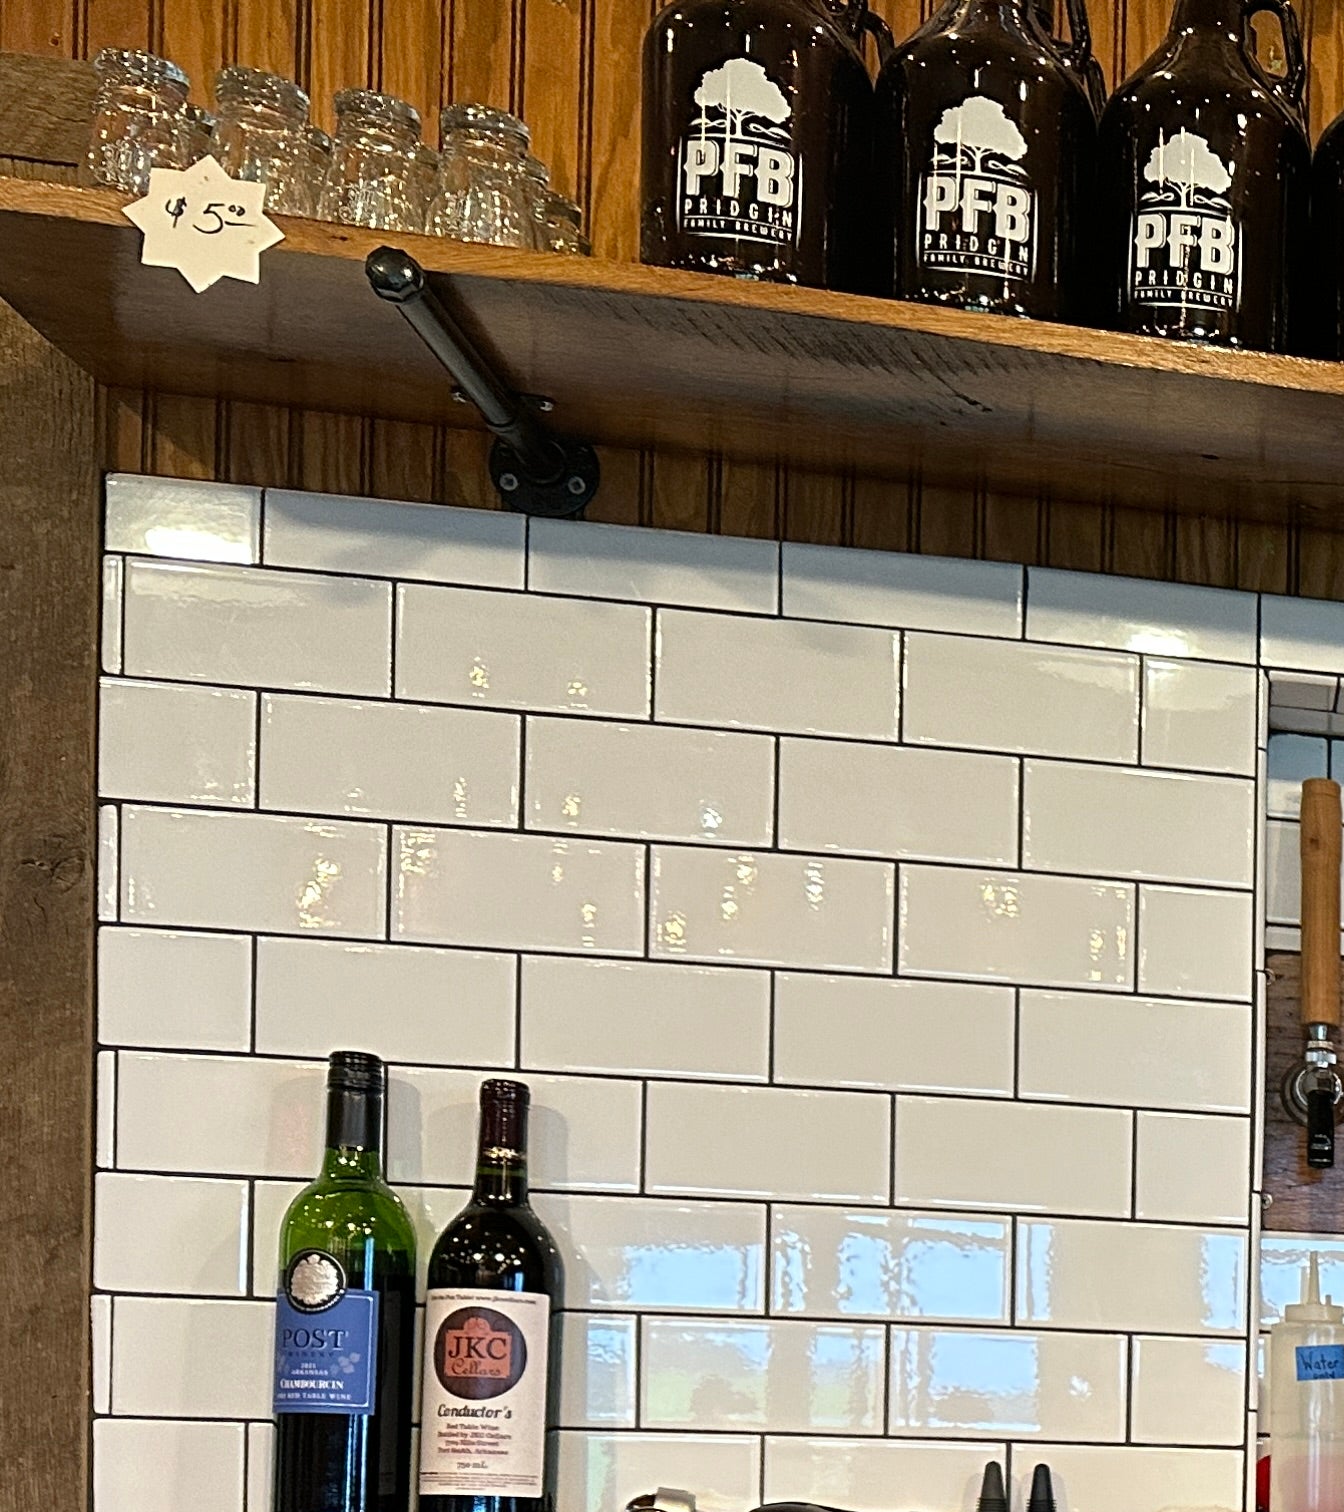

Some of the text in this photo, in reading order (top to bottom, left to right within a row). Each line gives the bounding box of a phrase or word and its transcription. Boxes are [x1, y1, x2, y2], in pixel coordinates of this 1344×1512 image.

[683, 139, 795, 208] PFB
[684, 198, 793, 227] PRIDGIN
[923, 176, 1030, 243] PFB
[1134, 213, 1236, 275] PFB
[1135, 270, 1233, 294] PRIDGIN
[282, 1327, 349, 1351] POST
[448, 1336, 507, 1361] JKC
[1300, 1350, 1339, 1370] Water
[438, 1404, 512, 1419] Conductor's
